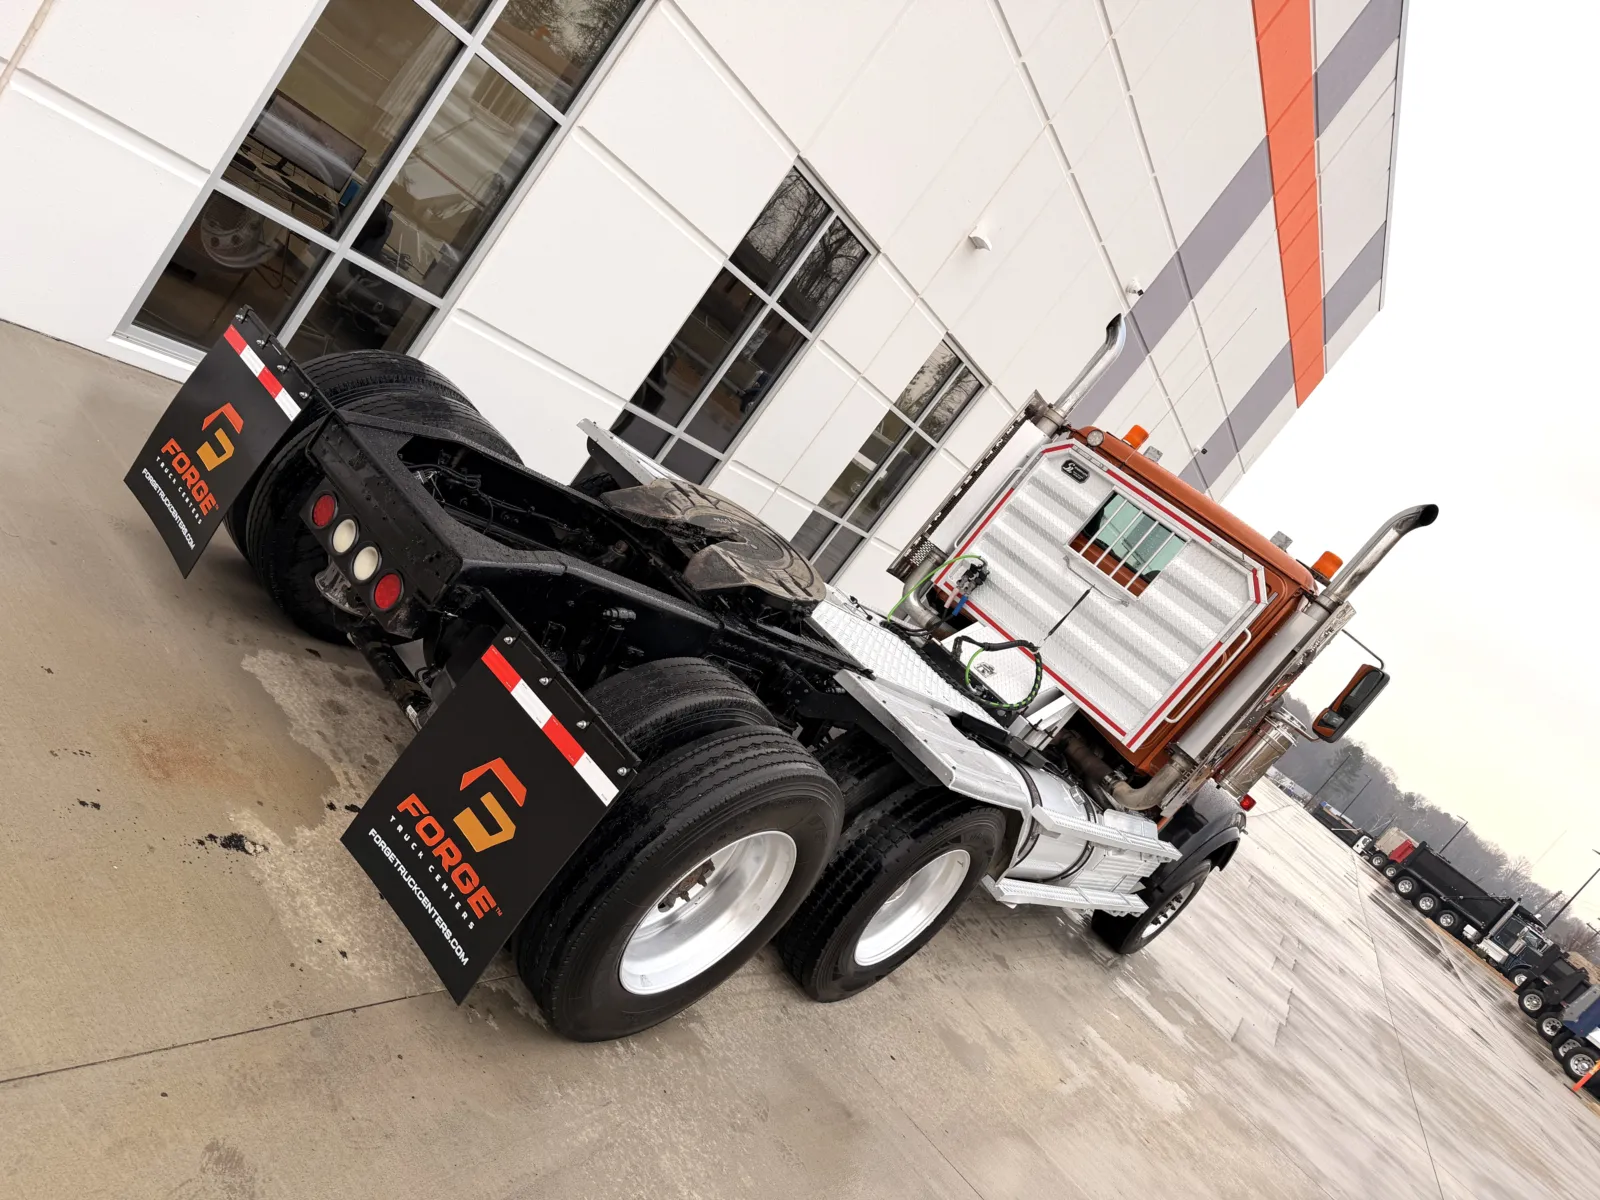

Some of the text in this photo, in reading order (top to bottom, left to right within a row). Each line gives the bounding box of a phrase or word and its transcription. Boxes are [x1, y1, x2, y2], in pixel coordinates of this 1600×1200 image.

[141, 467, 196, 550] FORGETRUCKCENTERS.COM
[156, 456, 203, 525] TRUCK CENTERS
[161, 438, 217, 516] FORGE
[368, 827, 470, 966] FORGETRUCKCENTERS.COM
[389, 814, 475, 930] TRUCK CENTERS
[396, 793, 497, 919] FORGE
